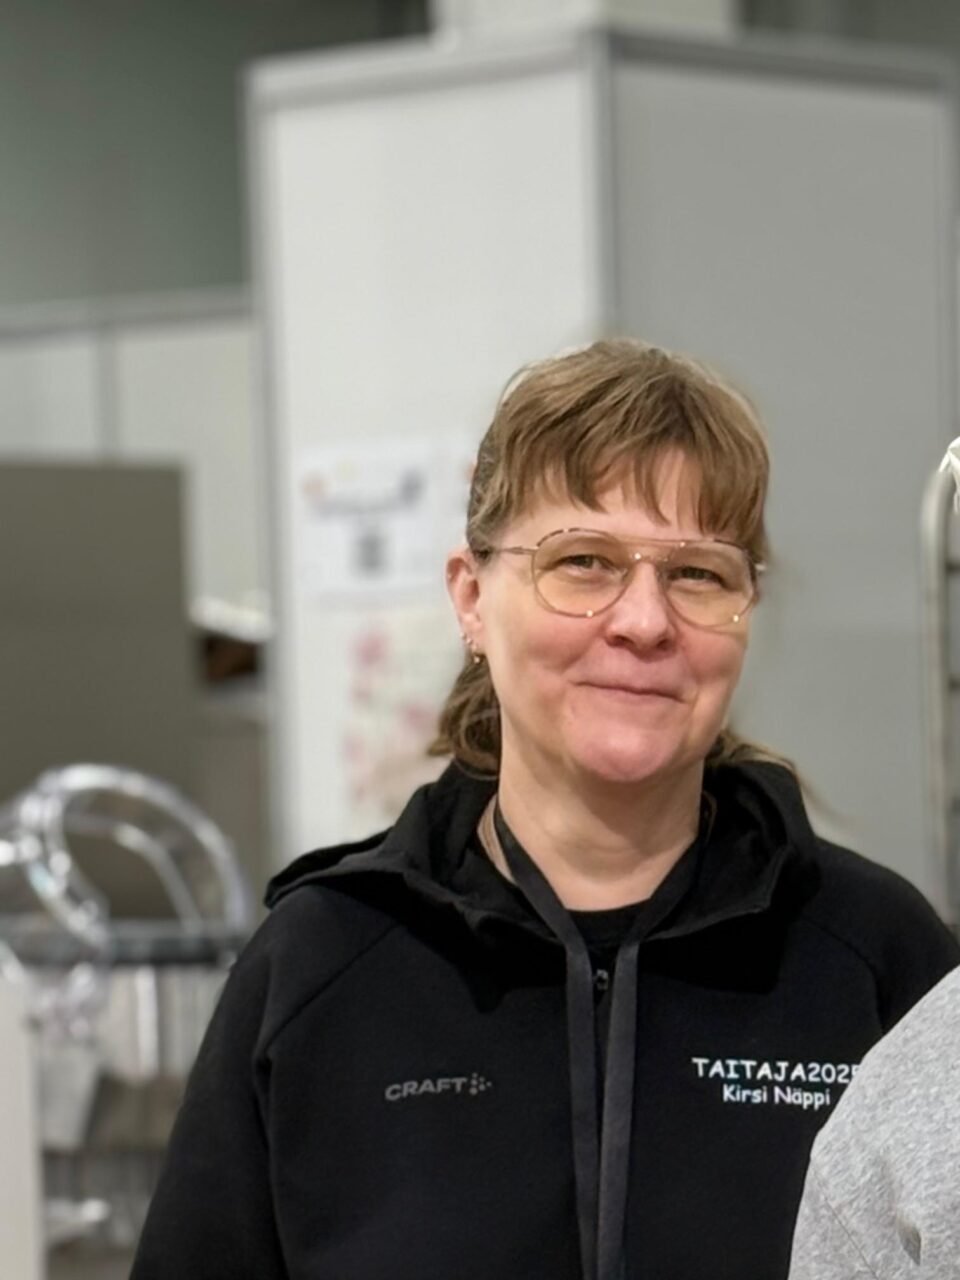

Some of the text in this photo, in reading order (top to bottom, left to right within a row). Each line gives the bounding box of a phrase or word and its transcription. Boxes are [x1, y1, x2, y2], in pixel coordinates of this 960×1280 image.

[385, 1077, 468, 1101] CRAFT
[722, 1083, 832, 1111] Kirsi Näppi
